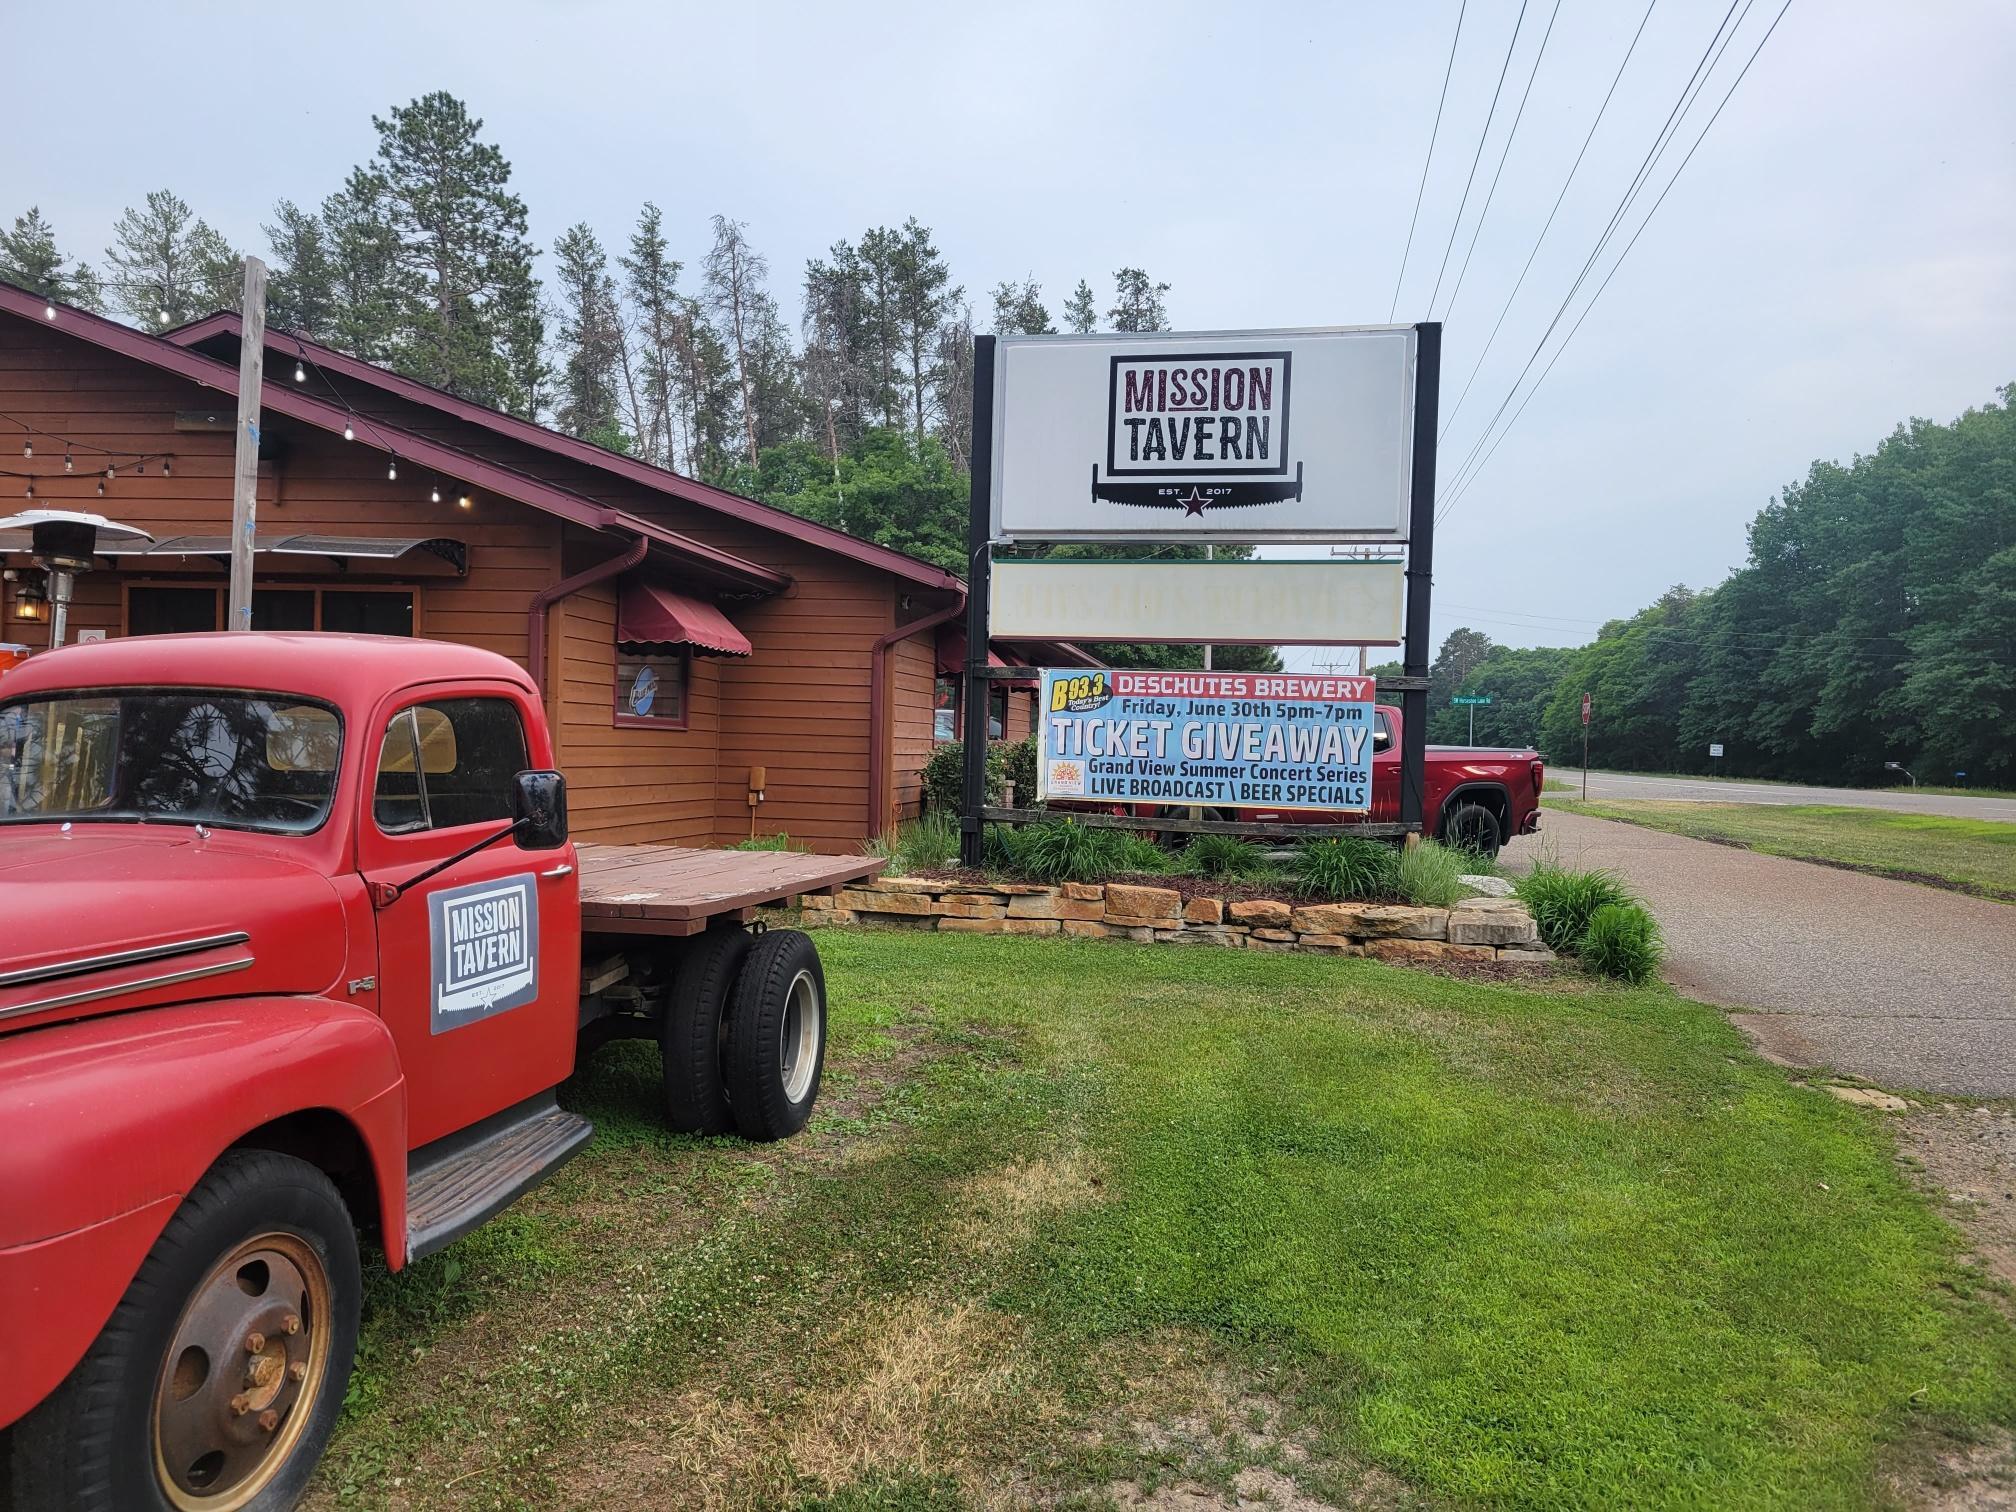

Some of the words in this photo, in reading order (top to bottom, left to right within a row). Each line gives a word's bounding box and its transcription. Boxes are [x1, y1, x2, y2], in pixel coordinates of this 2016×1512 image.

[1124, 367, 1273, 413] MISSION
[1123, 416, 1270, 461] TAVERN
[1051, 673, 1104, 711] B93.3
[1118, 675, 1247, 695] DESCHUTES
[1254, 679, 1367, 698] BREWERY
[1122, 699, 1181, 717] Friday,
[1186, 701, 1226, 716] June
[1231, 701, 1271, 717] 30th
[1276, 703, 1363, 722] 5pm-7pm
[1051, 717, 1173, 758] TICKET
[1181, 720, 1369, 765] GIVEAWAY
[1088, 758, 1134, 775] Grand
[1138, 760, 1176, 776] View
[1180, 761, 1246, 778] Summer
[1250, 764, 1312, 781] Concert
[1316, 766, 1367, 783] Series
[1091, 778, 1126, 795] LIVE
[1130, 779, 1226, 799] BROADCAST
[1240, 782, 1282, 801] BEER
[1286, 784, 1365, 805] SPECIALS
[452, 896, 520, 943] MISSION
[453, 930, 520, 977] TAVERN
